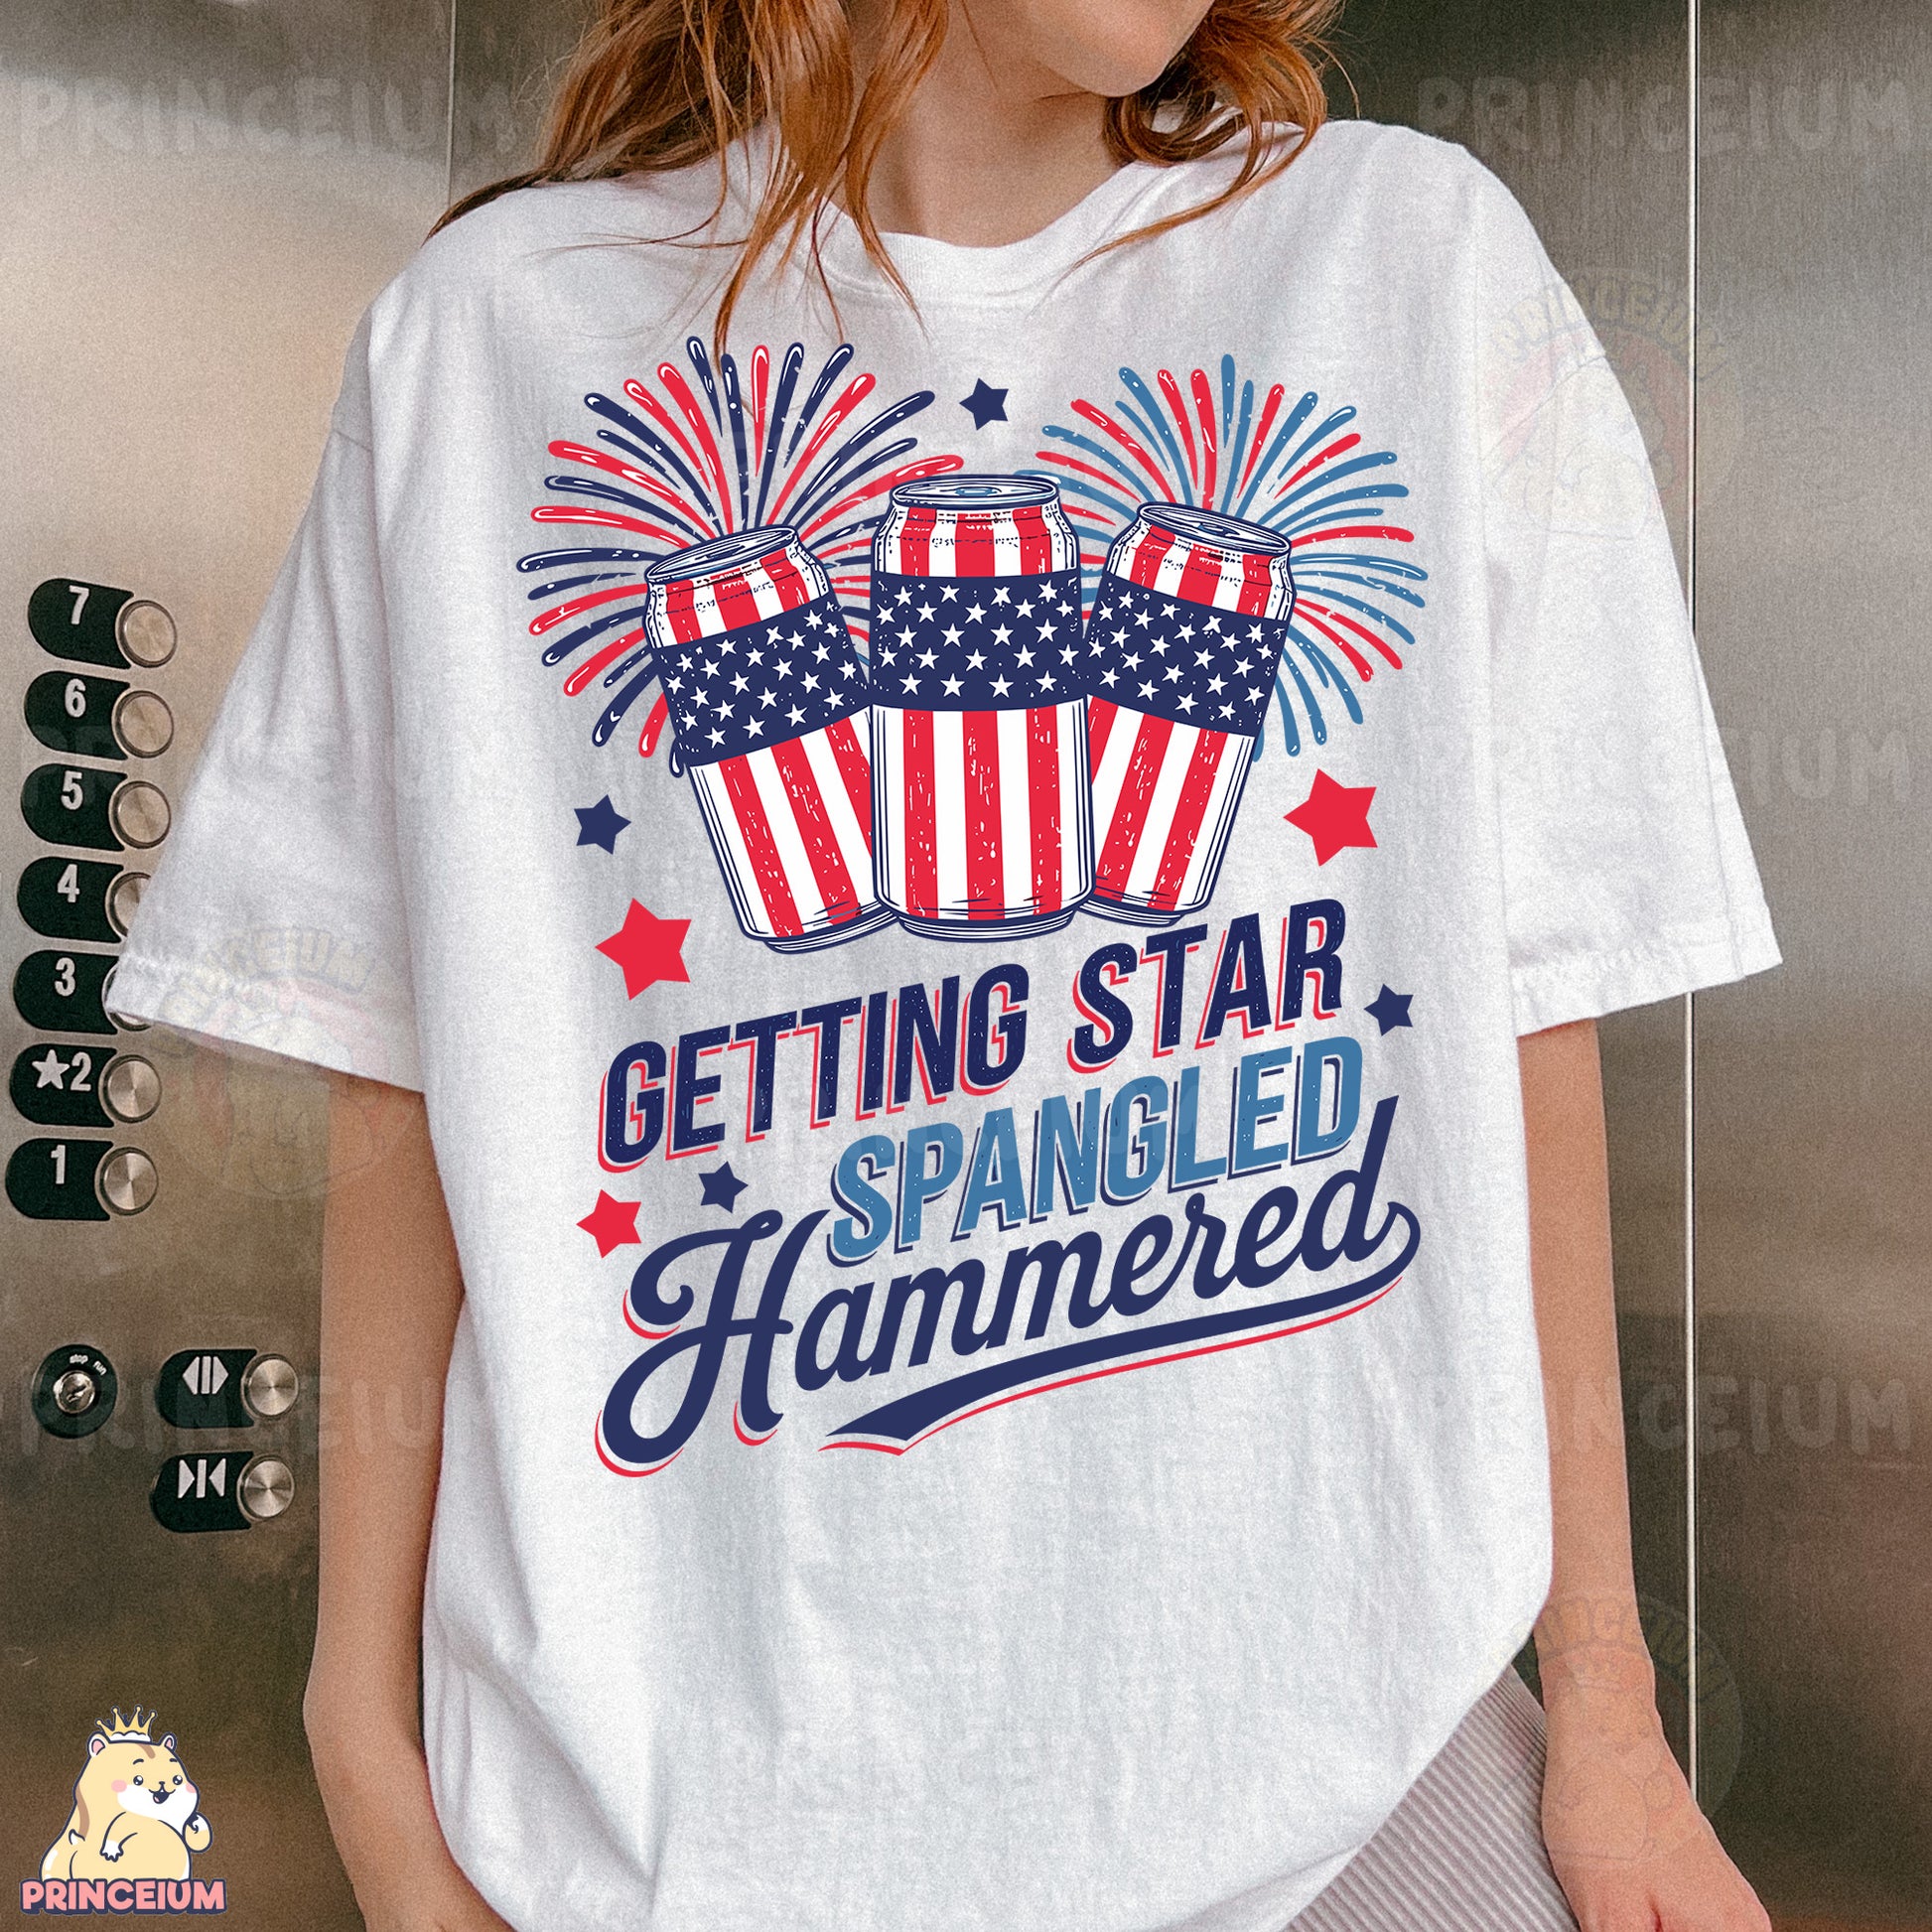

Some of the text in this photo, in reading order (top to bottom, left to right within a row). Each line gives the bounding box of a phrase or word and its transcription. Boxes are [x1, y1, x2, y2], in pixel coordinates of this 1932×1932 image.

[68, 585, 89, 624] 7
[66, 678, 86, 717] 6
[62, 771, 83, 809] 5
[58, 864, 79, 902] 4
[56, 958, 75, 996] 3
[598, 963, 1030, 1173] GETTING
[1067, 899, 1345, 1074] STAR
[70, 1052, 90, 1091] 2
[51, 1145, 67, 1183] 1
[827, 1036, 1363, 1266] SPANGLED
[596, 1096, 1421, 1477] Hammered
